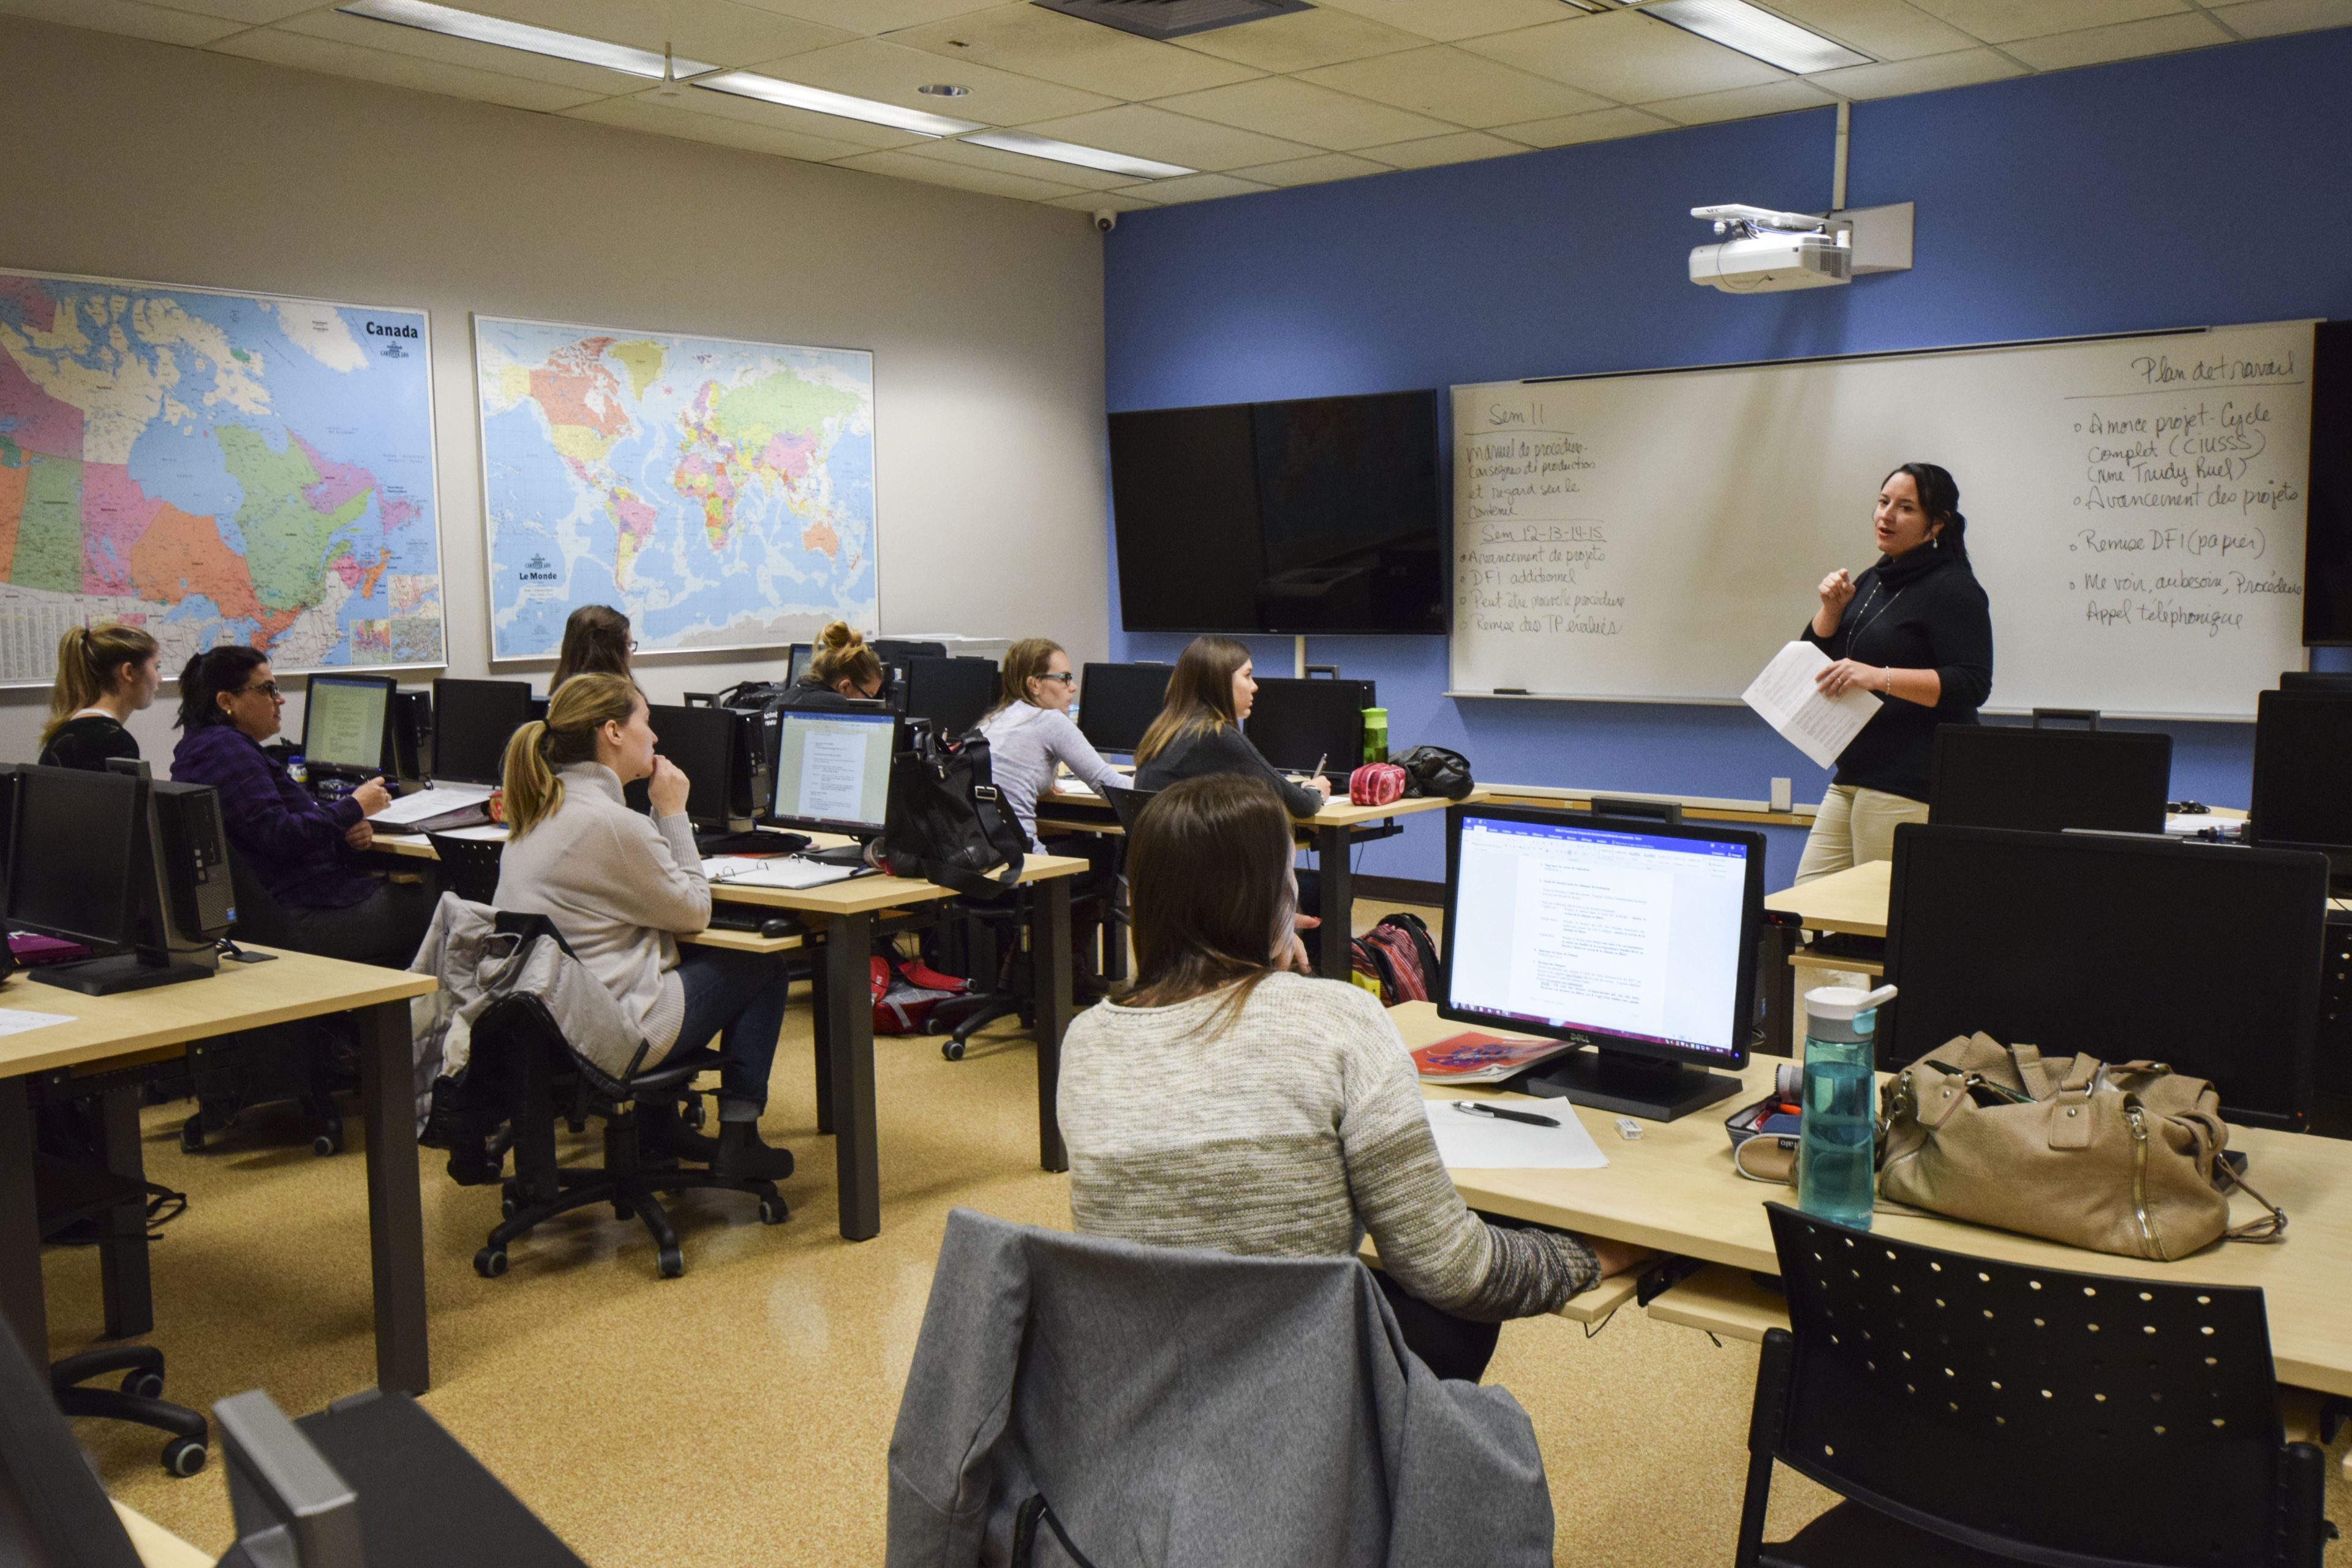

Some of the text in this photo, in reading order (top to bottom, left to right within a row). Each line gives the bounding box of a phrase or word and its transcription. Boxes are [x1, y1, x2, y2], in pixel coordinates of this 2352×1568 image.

[366, 321, 418, 339] Canada
[2132, 355, 2184, 383] Plan
[1489, 402, 1544, 426] Sem 11
[2089, 413, 2147, 435] Amorce
[2156, 402, 2208, 439] projet
[2222, 401, 2271, 436] Cycle
[1518, 442, 1531, 458] de
[1542, 456, 1596, 477] production
[2132, 462, 2188, 488] Trudy
[2196, 456, 2247, 481] Ruel)
[1468, 484, 1483, 499] et
[1491, 483, 1537, 506] regard
[1564, 478, 1580, 493] le
[2085, 480, 2299, 516] Avancement des projets
[1482, 524, 1604, 542] Sem 12-13-14-15
[2078, 528, 2144, 552] Remise
[2188, 527, 2266, 560] (papier)
[1469, 545, 1606, 570] Avancement de projets
[519, 572, 529, 581] Le
[1510, 567, 1577, 584] additionnel
[2085, 573, 2106, 590] Me
[1532, 587, 1572, 610] nouvelle
[1470, 613, 1515, 632] Remise
[1520, 615, 1541, 633] des
[1542, 614, 1563, 633] TP
[2086, 598, 2243, 638] Appel téléphonique
